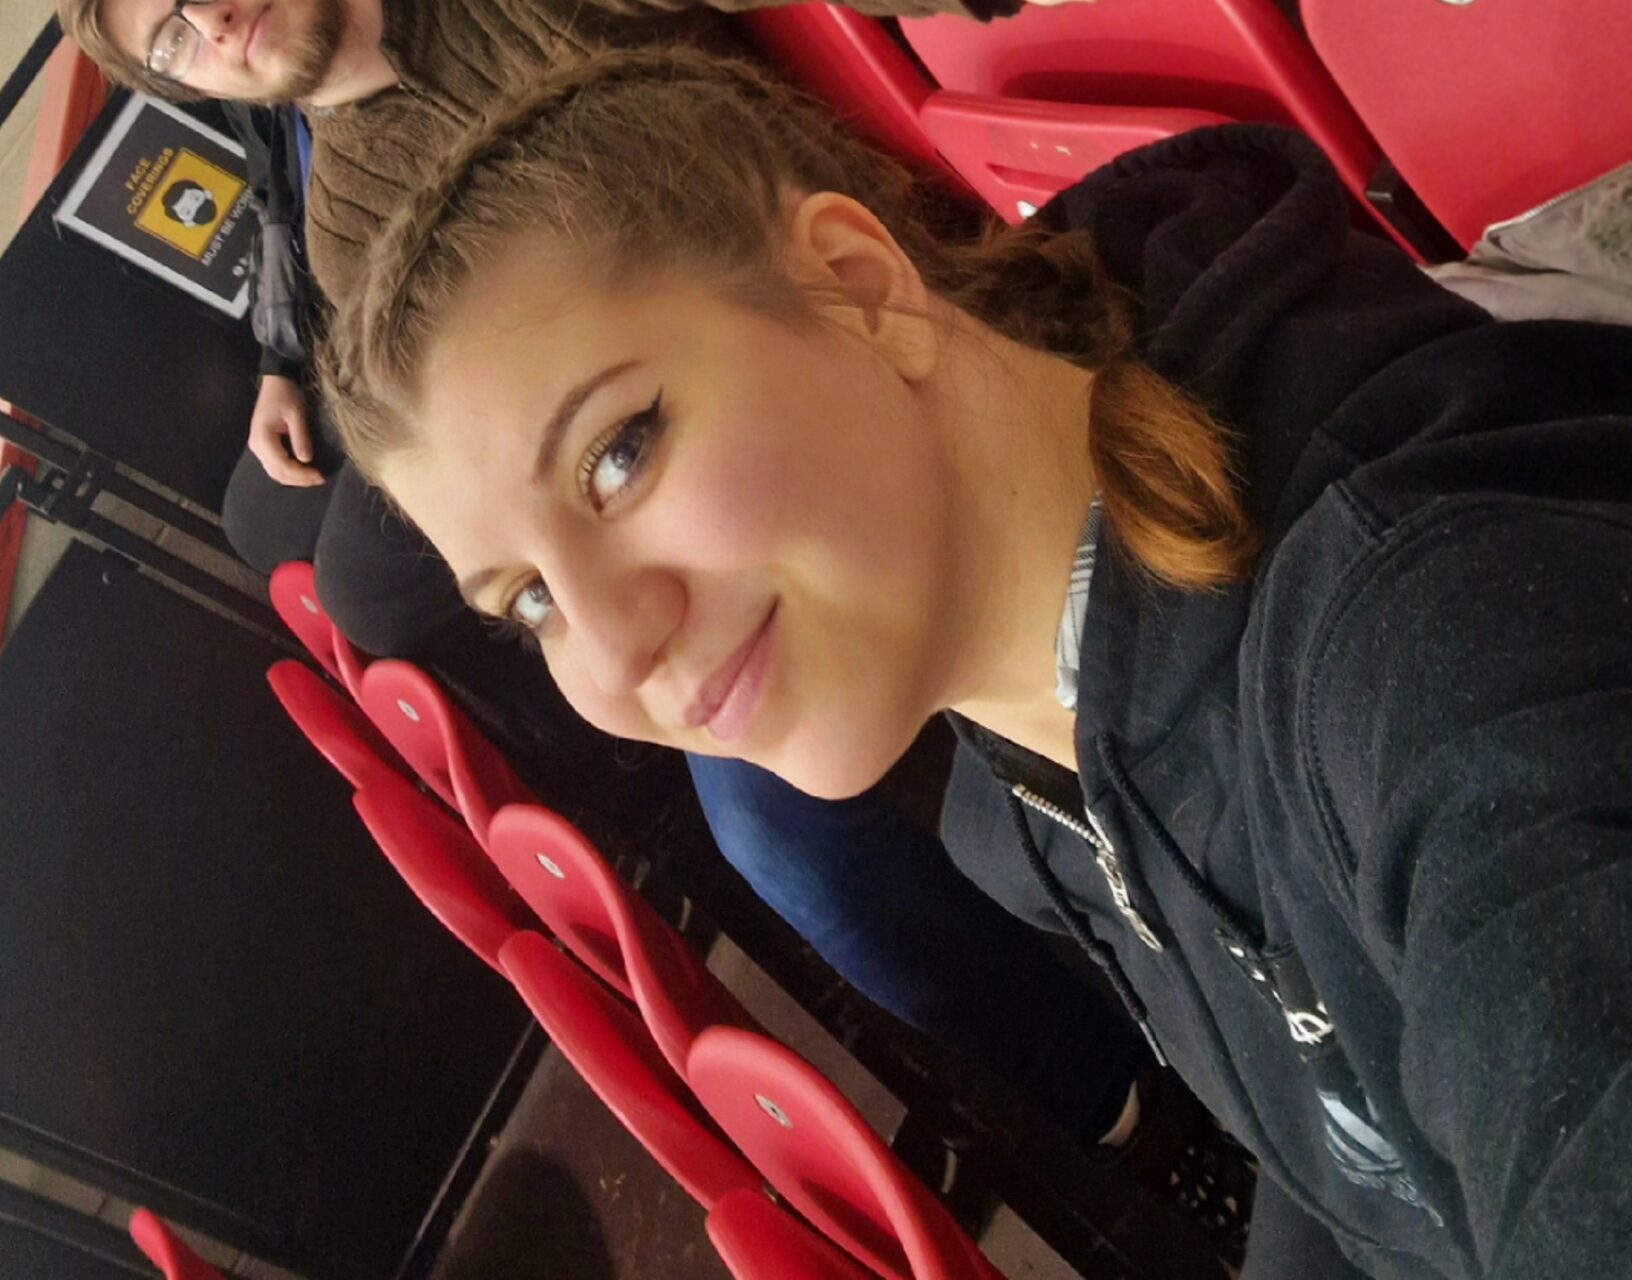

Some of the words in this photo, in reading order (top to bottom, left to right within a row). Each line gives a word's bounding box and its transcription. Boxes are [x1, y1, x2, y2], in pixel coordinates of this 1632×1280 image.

[125, 157, 151, 191] FACE
[127, 147, 174, 215] COVERINGS
[201, 233, 225, 267] MUST
[220, 218, 236, 236] BE
